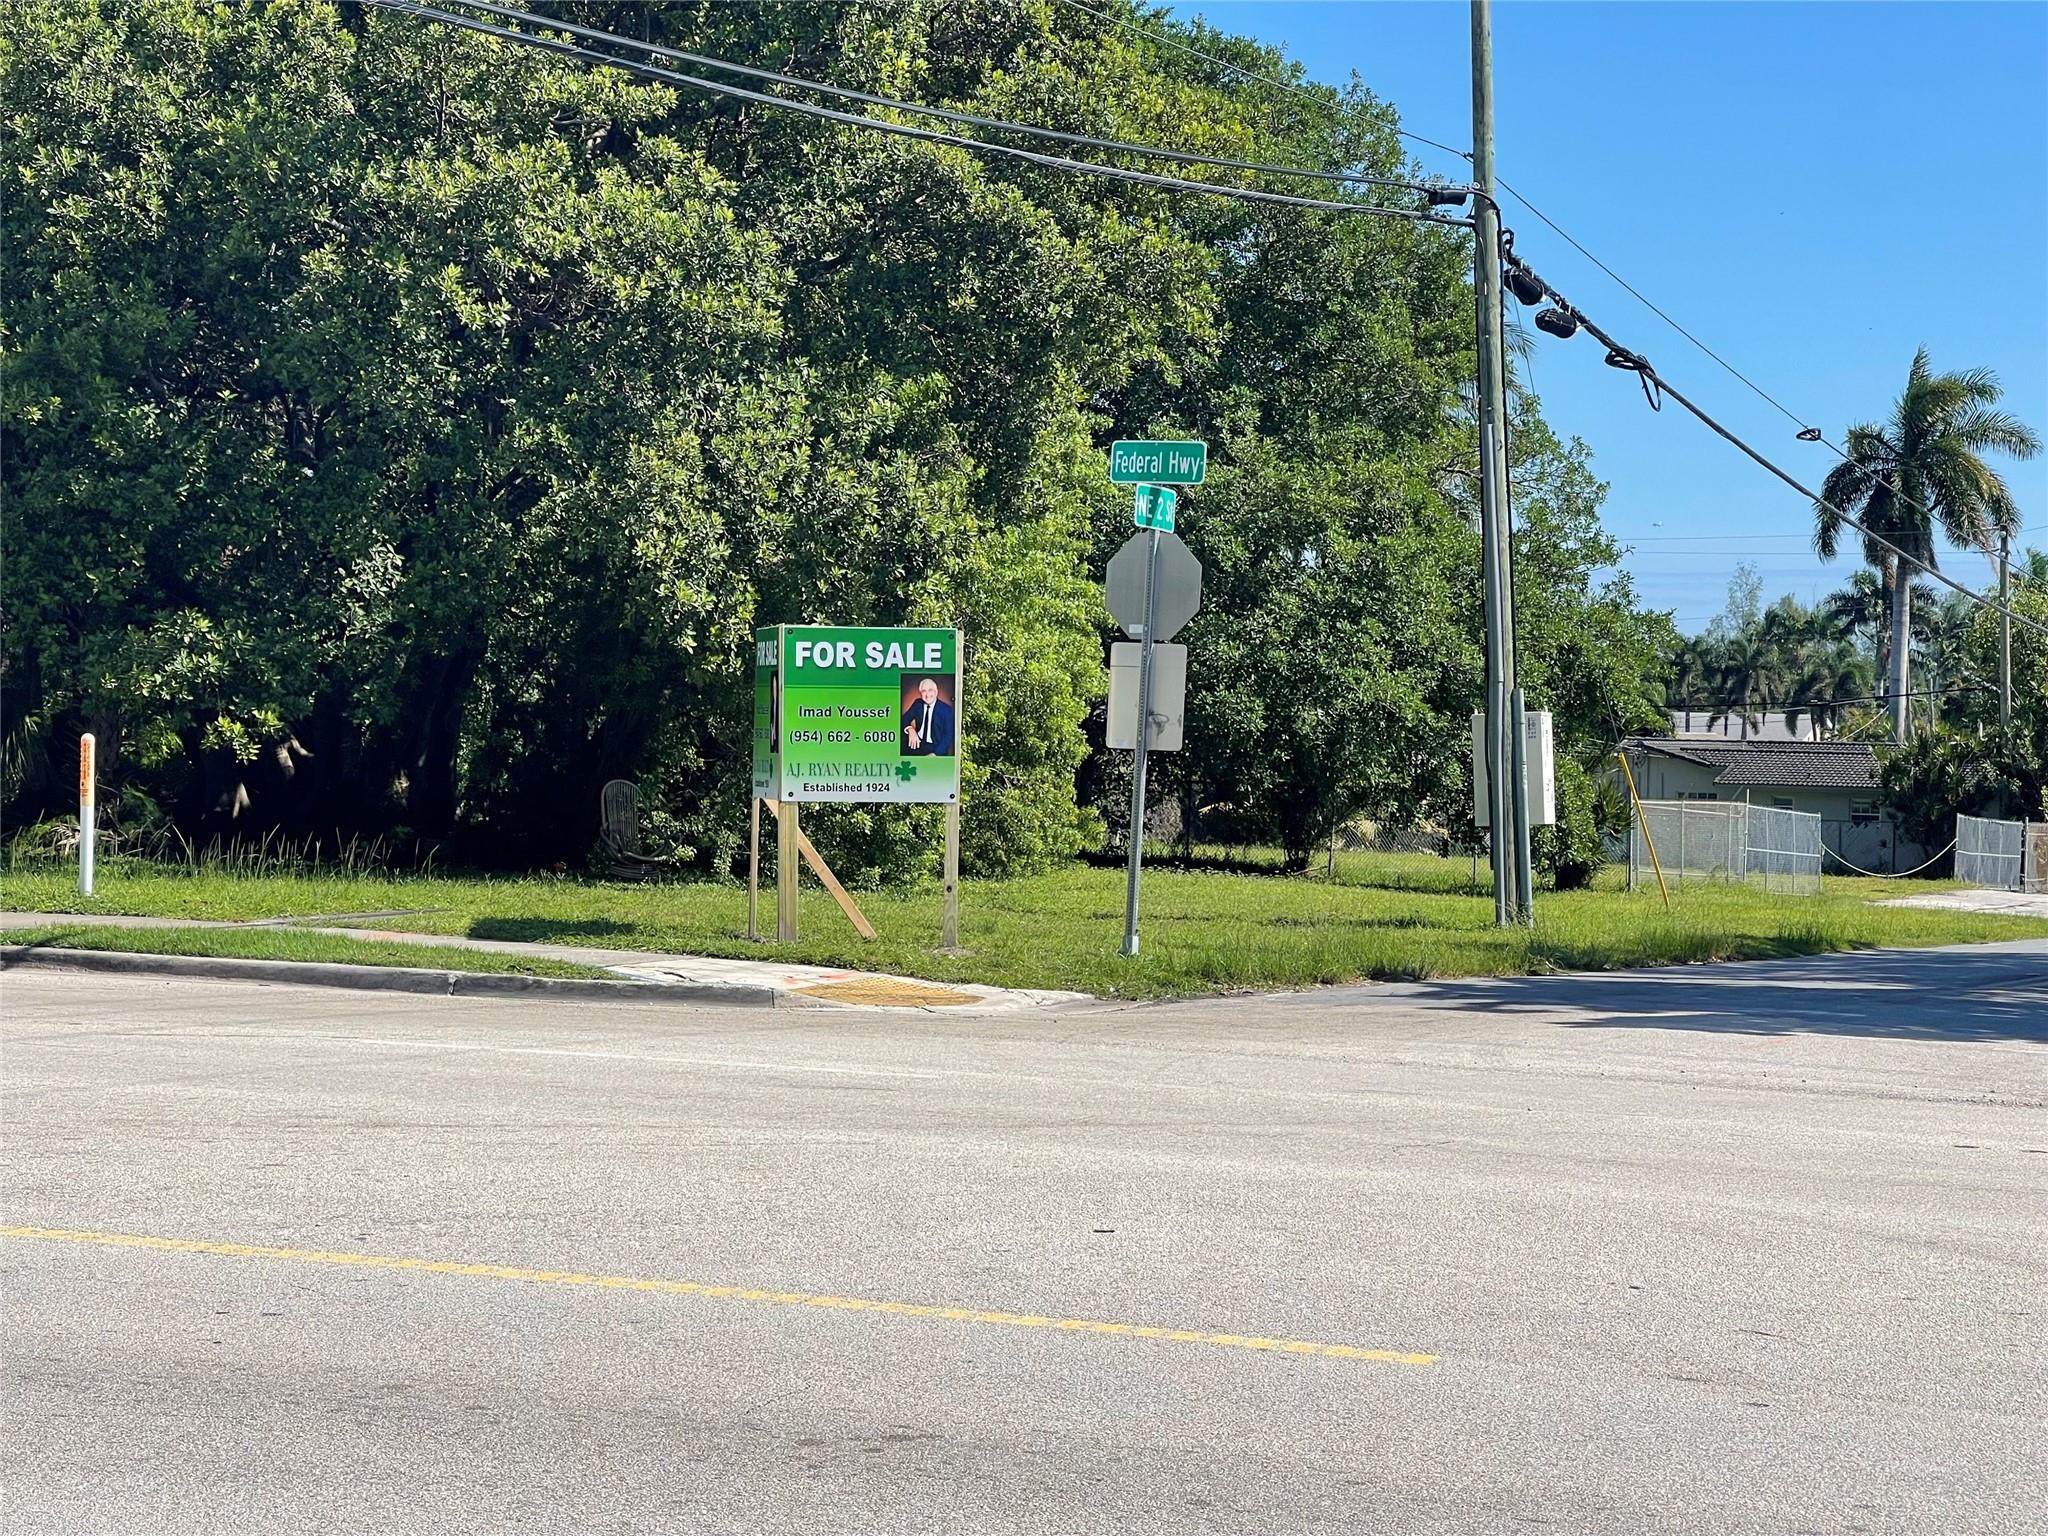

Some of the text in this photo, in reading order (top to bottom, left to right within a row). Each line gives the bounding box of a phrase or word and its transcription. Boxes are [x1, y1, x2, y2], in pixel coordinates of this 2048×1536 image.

[1115, 451, 1200, 480] Federal Hwy
[1138, 494, 1153, 518] NE
[1157, 497, 1163, 520] 2
[795, 641, 942, 669] FOR SALE
[799, 706, 890, 718] Imad Youssef
[789, 730, 823, 744] (954)
[827, 731, 851, 743] 662
[864, 731, 896, 743] 6080
[809, 763, 841, 777] RYAN
[845, 763, 893, 777] REALTY
[803, 783, 890, 793] Established 1924
